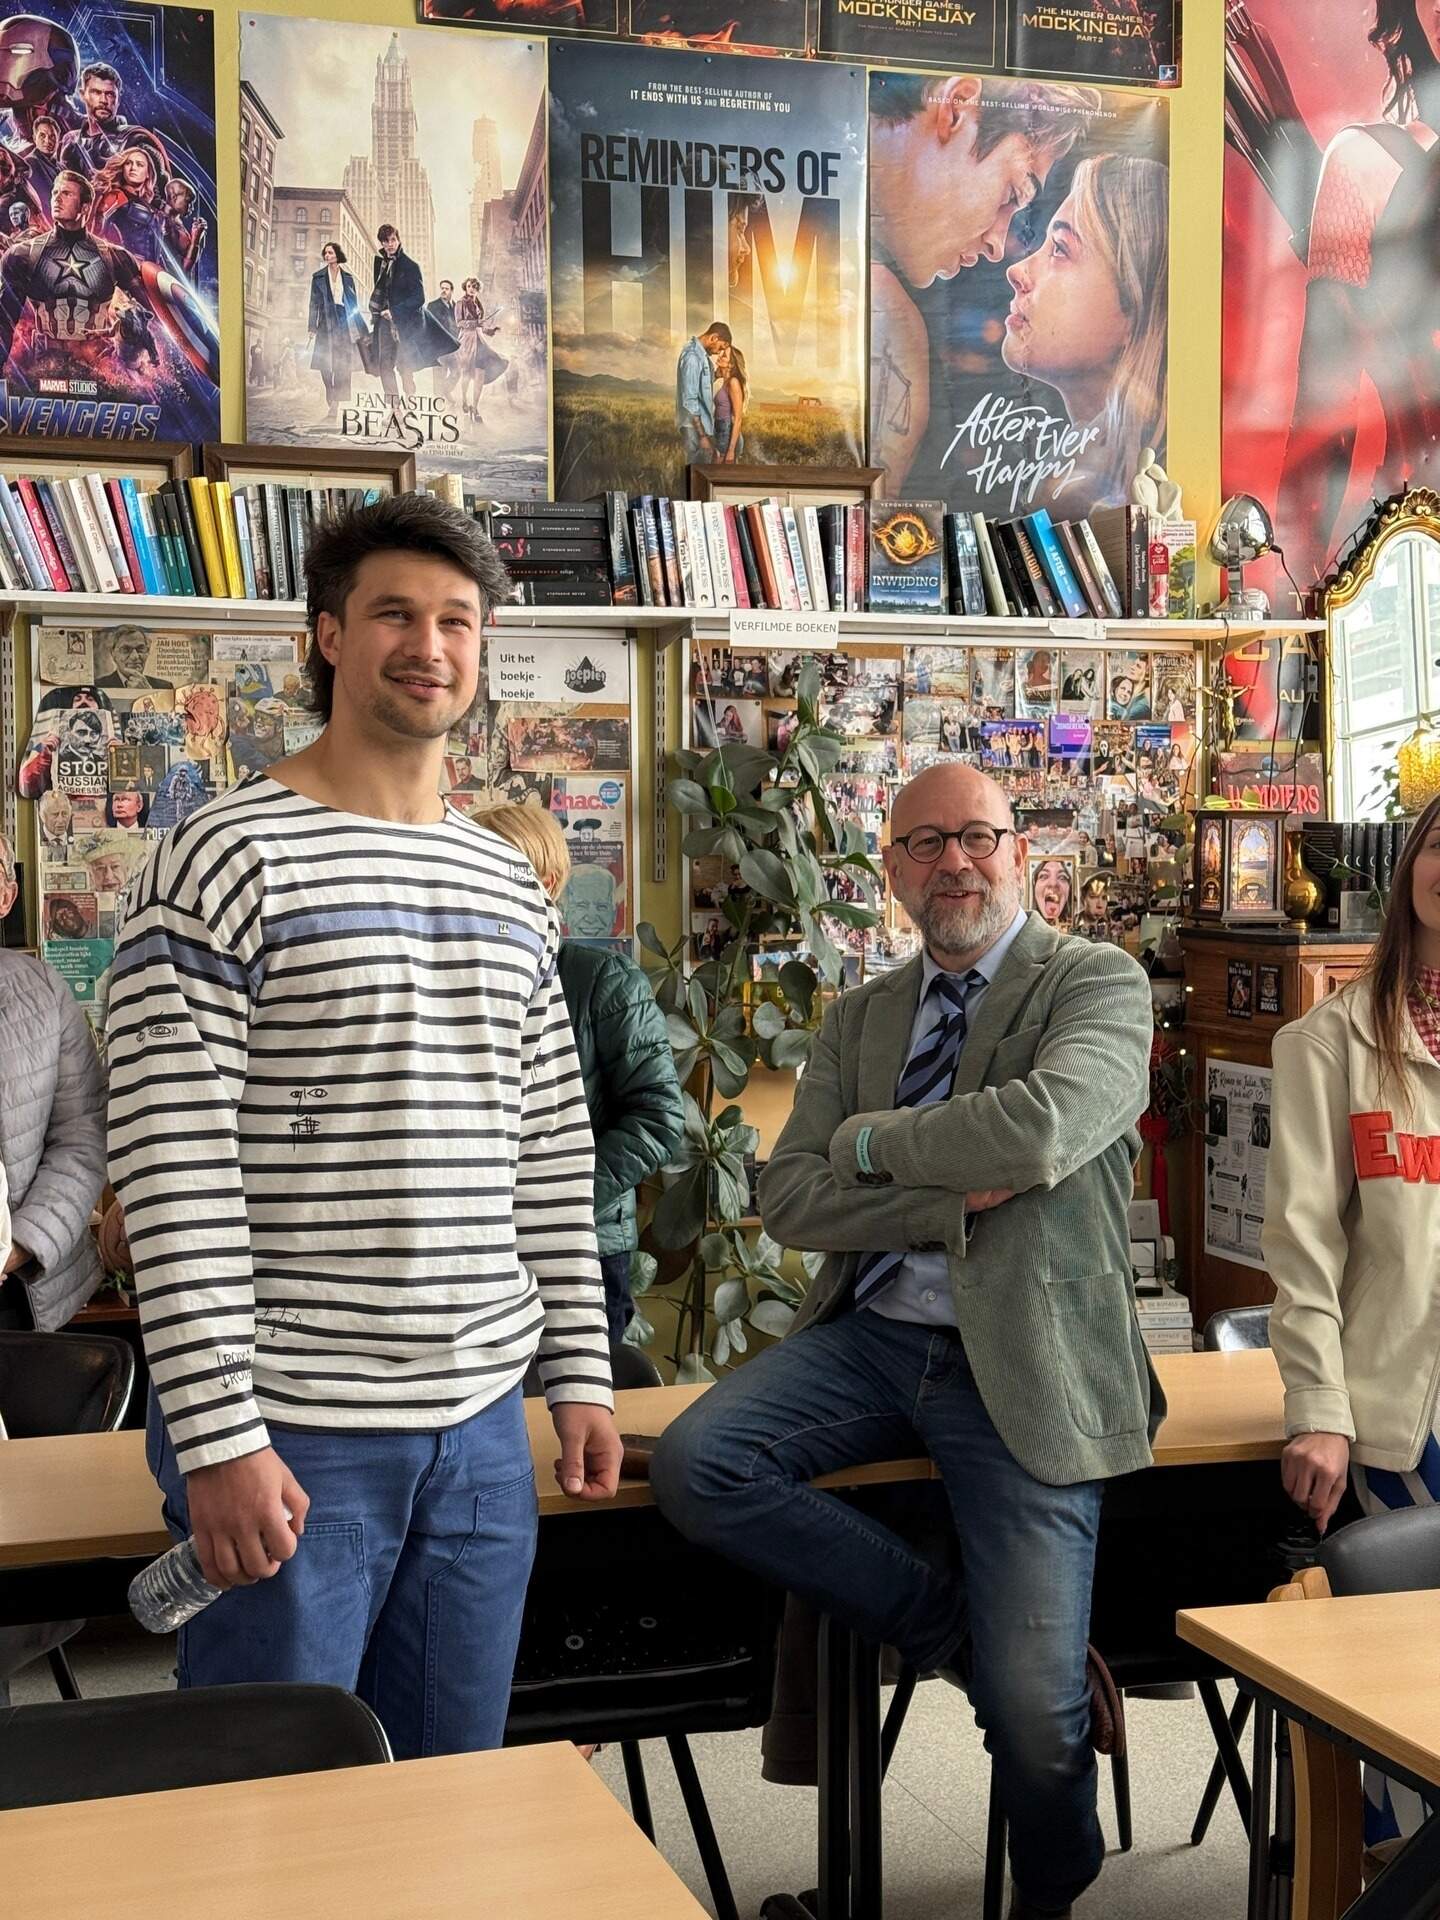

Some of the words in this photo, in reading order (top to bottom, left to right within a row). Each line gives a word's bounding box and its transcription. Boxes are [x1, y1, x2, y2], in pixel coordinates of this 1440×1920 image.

[838, 1, 976, 25] MOCKINGJAY
[1036, 6, 1058, 15] THE
[1061, 10, 1104, 20] HUNGER
[1107, 14, 1143, 24] GAMES
[896, 19, 918, 28] PART
[1022, 13, 1155, 38] MOCKINGJAY
[1077, 34, 1097, 43] PART
[648, 82, 668, 92] FROM
[670, 84, 683, 93] THE
[685, 85, 733, 98] BEST-SELLING
[735, 88, 761, 100] AUTHOR
[764, 91, 772, 100] OF
[630, 90, 639, 100] IT
[642, 91, 664, 103] ENDS
[667, 93, 688, 105] WITH
[690, 95, 702, 106] US
[704, 97, 717, 107] AND
[719, 97, 772, 112] REGRETTING
[774, 102, 791, 113] YOU
[581, 132, 786, 194] REMINDERS
[797, 150, 841, 196] OF
[582, 180, 841, 350] HIM
[39, 380, 68, 392] MARVEL
[69, 380, 98, 395] STUDIOS
[356, 392, 445, 412] FANTASTIC
[341, 408, 460, 447] BEASTS
[940, 392, 1048, 470] After
[1034, 415, 1099, 460] Ever
[967, 445, 1085, 513] Happy
[646, 518, 658, 542] BOY
[661, 520, 674, 544] BOY
[679, 539, 690, 569] Trash
[1052, 552, 1066, 577] AFTER
[872, 575, 938, 589] INWIJDING
[734, 620, 792, 632] VERFILMDE
[796, 623, 837, 633] BOEKEN
[500, 654, 515, 664] Uit
[517, 654, 535, 664] het
[500, 671, 535, 681] boekje
[500, 688, 535, 699] hoekje
[59, 760, 107, 776] STOP
[58, 776, 108, 787] RUSSIAN
